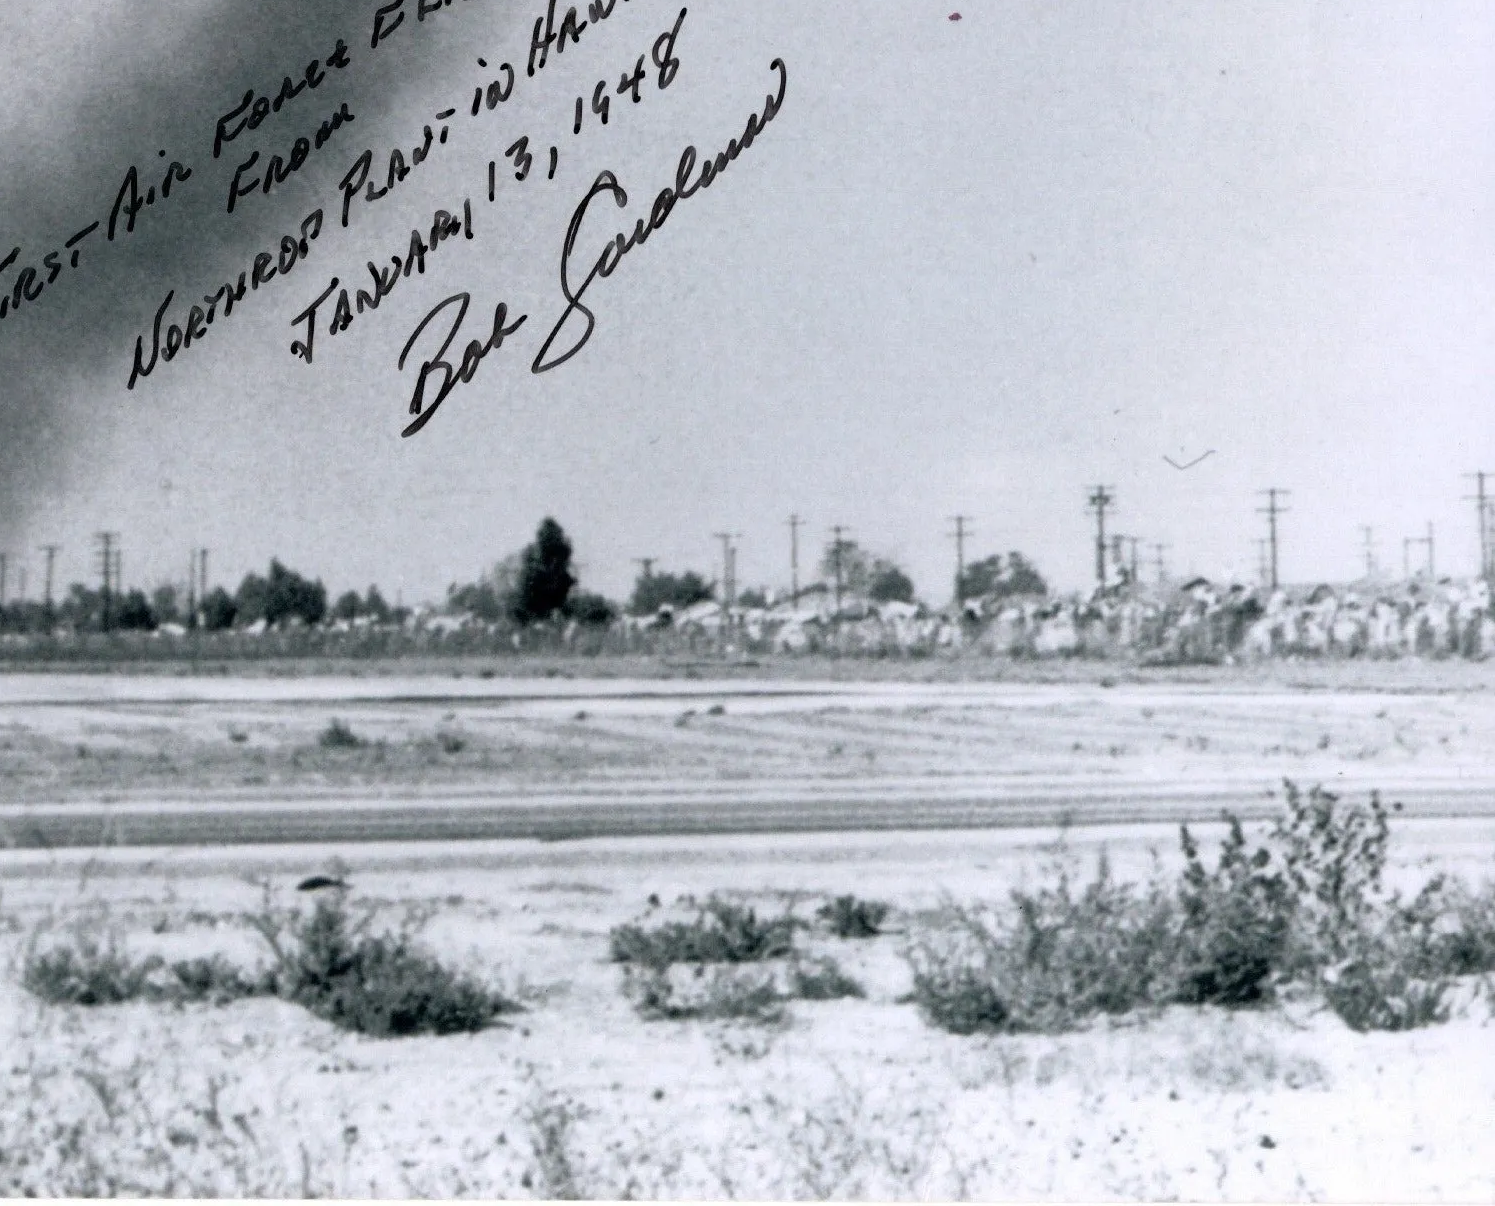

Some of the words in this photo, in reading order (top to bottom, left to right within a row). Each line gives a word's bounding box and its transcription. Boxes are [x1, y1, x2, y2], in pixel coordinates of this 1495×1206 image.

[126, 208, 324, 391] NORTHROP
[338, 102, 456, 228] PLANT
[226, 102, 356, 215] FROM
[290, 200, 474, 364] JANUARY
[488, 136, 558, 203] 13,
[573, 7, 688, 135] 1948
[397, 292, 528, 438] Bob
